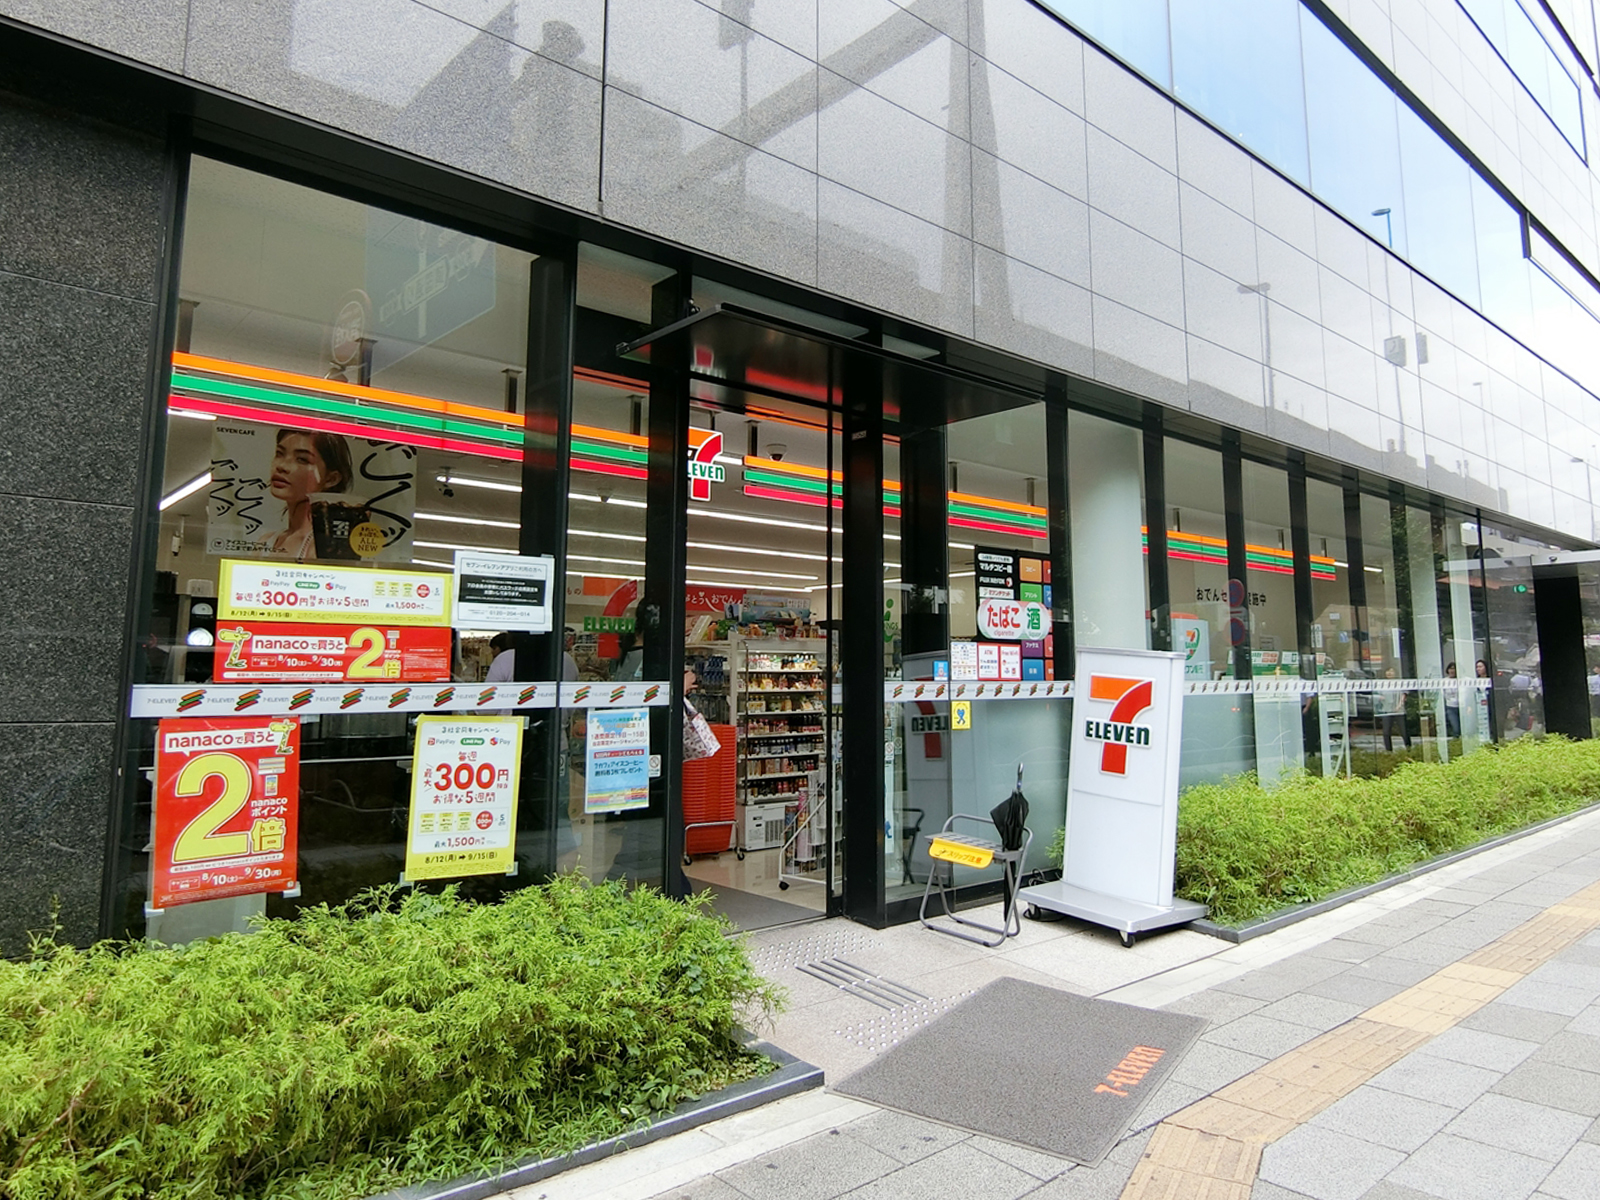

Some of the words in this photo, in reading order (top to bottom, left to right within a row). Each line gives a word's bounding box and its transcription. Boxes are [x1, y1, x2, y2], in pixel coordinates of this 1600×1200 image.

[987, 604, 1021, 629] たばこ
[1026, 607, 1041, 631] 酒
[1089, 675, 1153, 776] 7
[168, 731, 275, 749] nanacoで買うと
[171, 751, 253, 865] 2
[251, 797, 288, 807] nanaco
[251, 805, 287, 818] ポイント
[250, 816, 287, 854] 倍
